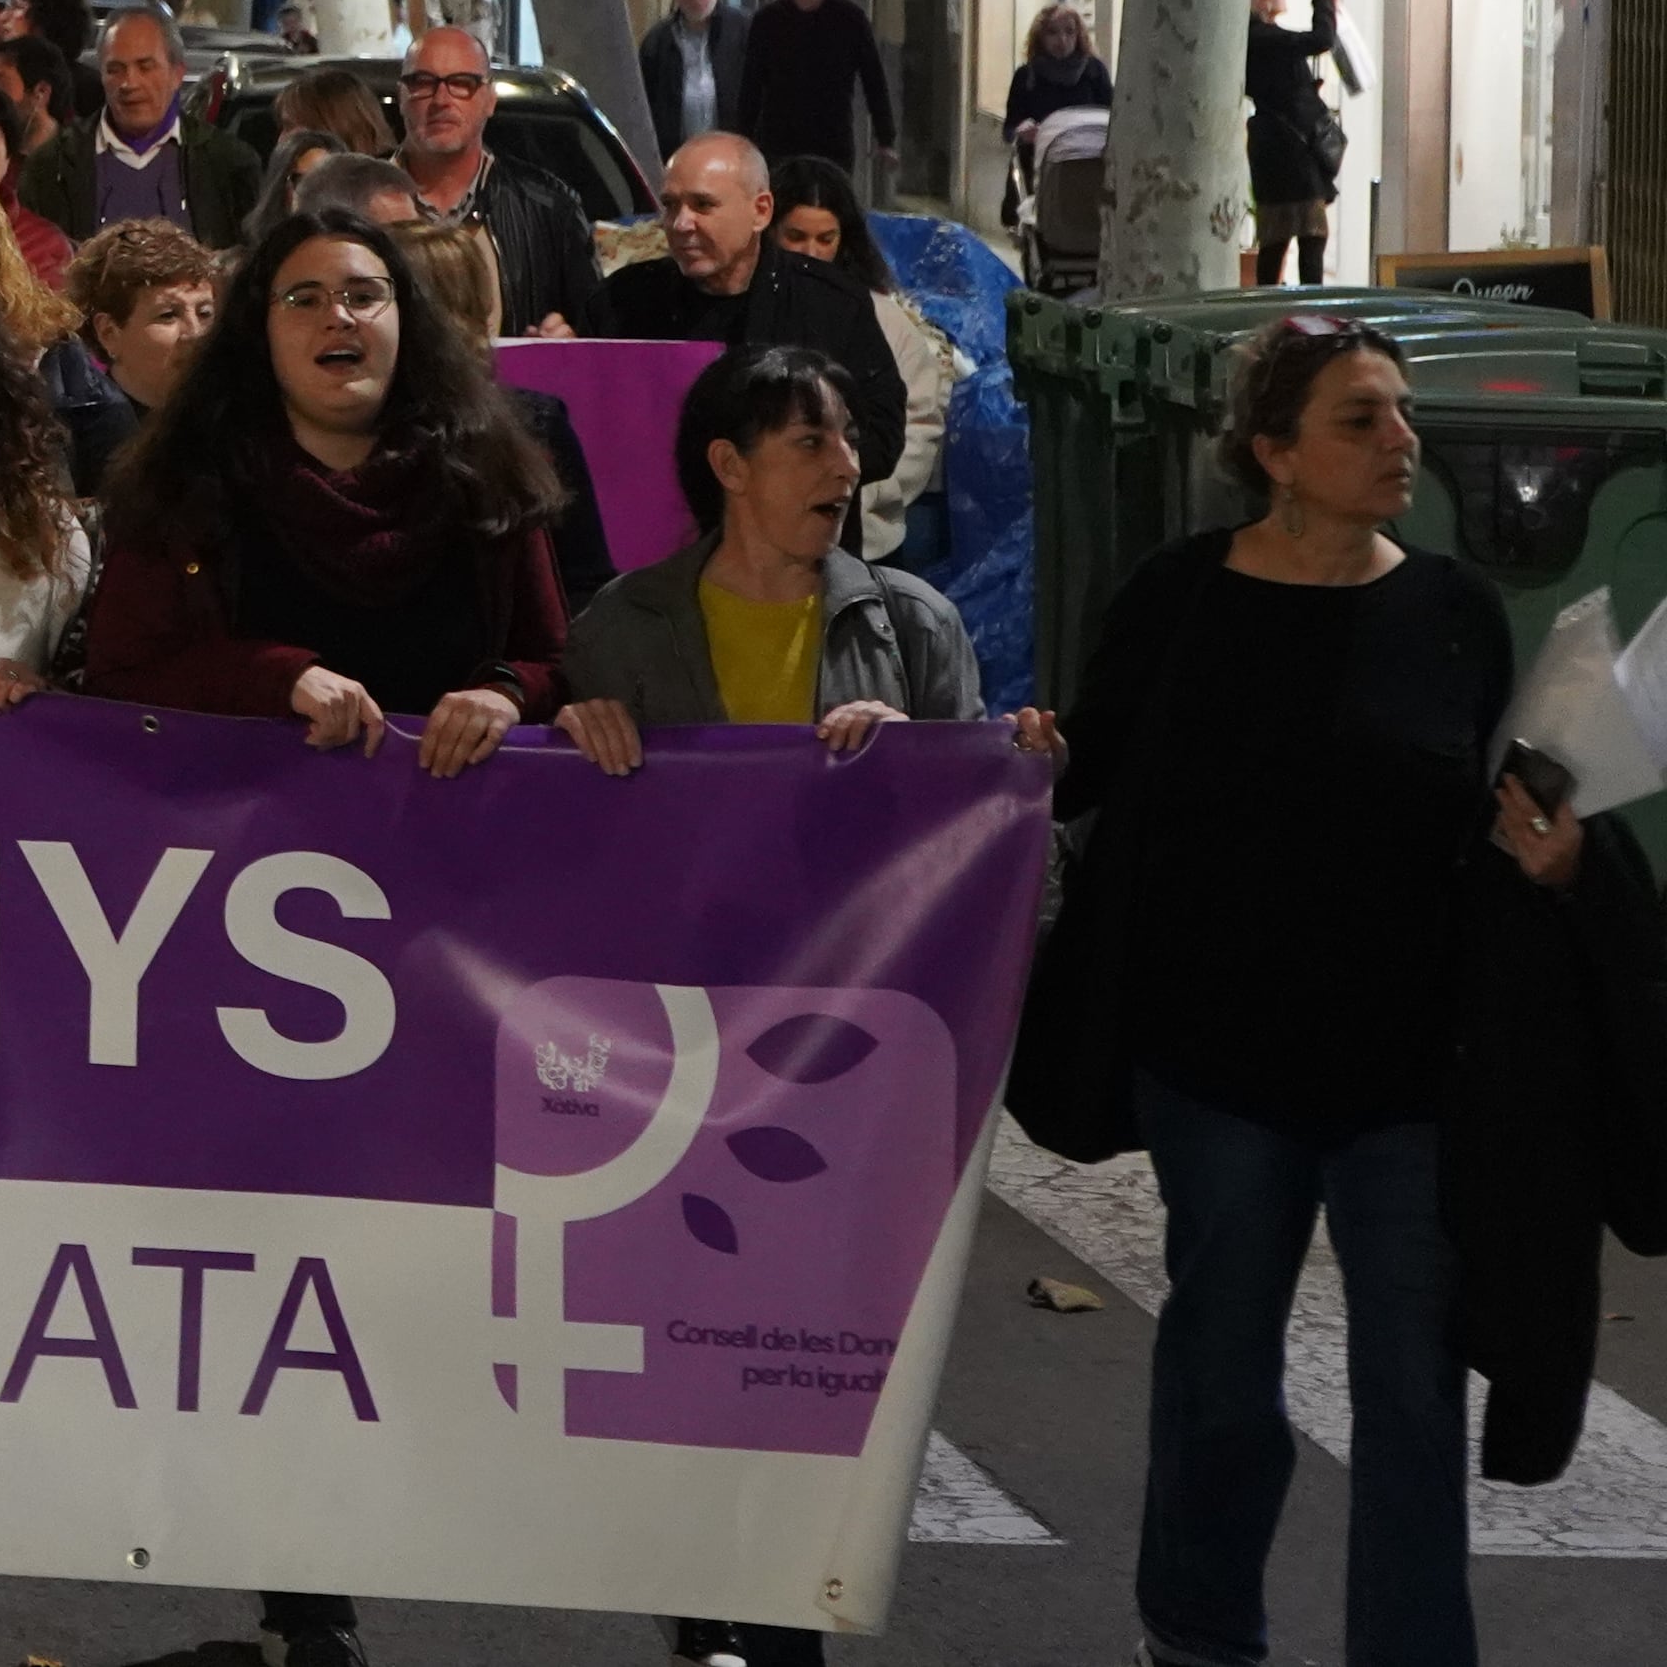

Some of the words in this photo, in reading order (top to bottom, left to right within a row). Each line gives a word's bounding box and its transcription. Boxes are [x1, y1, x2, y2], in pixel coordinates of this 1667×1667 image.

[667, 1319, 758, 1349] Consell
[761, 1327, 797, 1352] de
[799, 1328, 835, 1353] les
[741, 1366, 788, 1392] per
[790, 1364, 814, 1389] la
